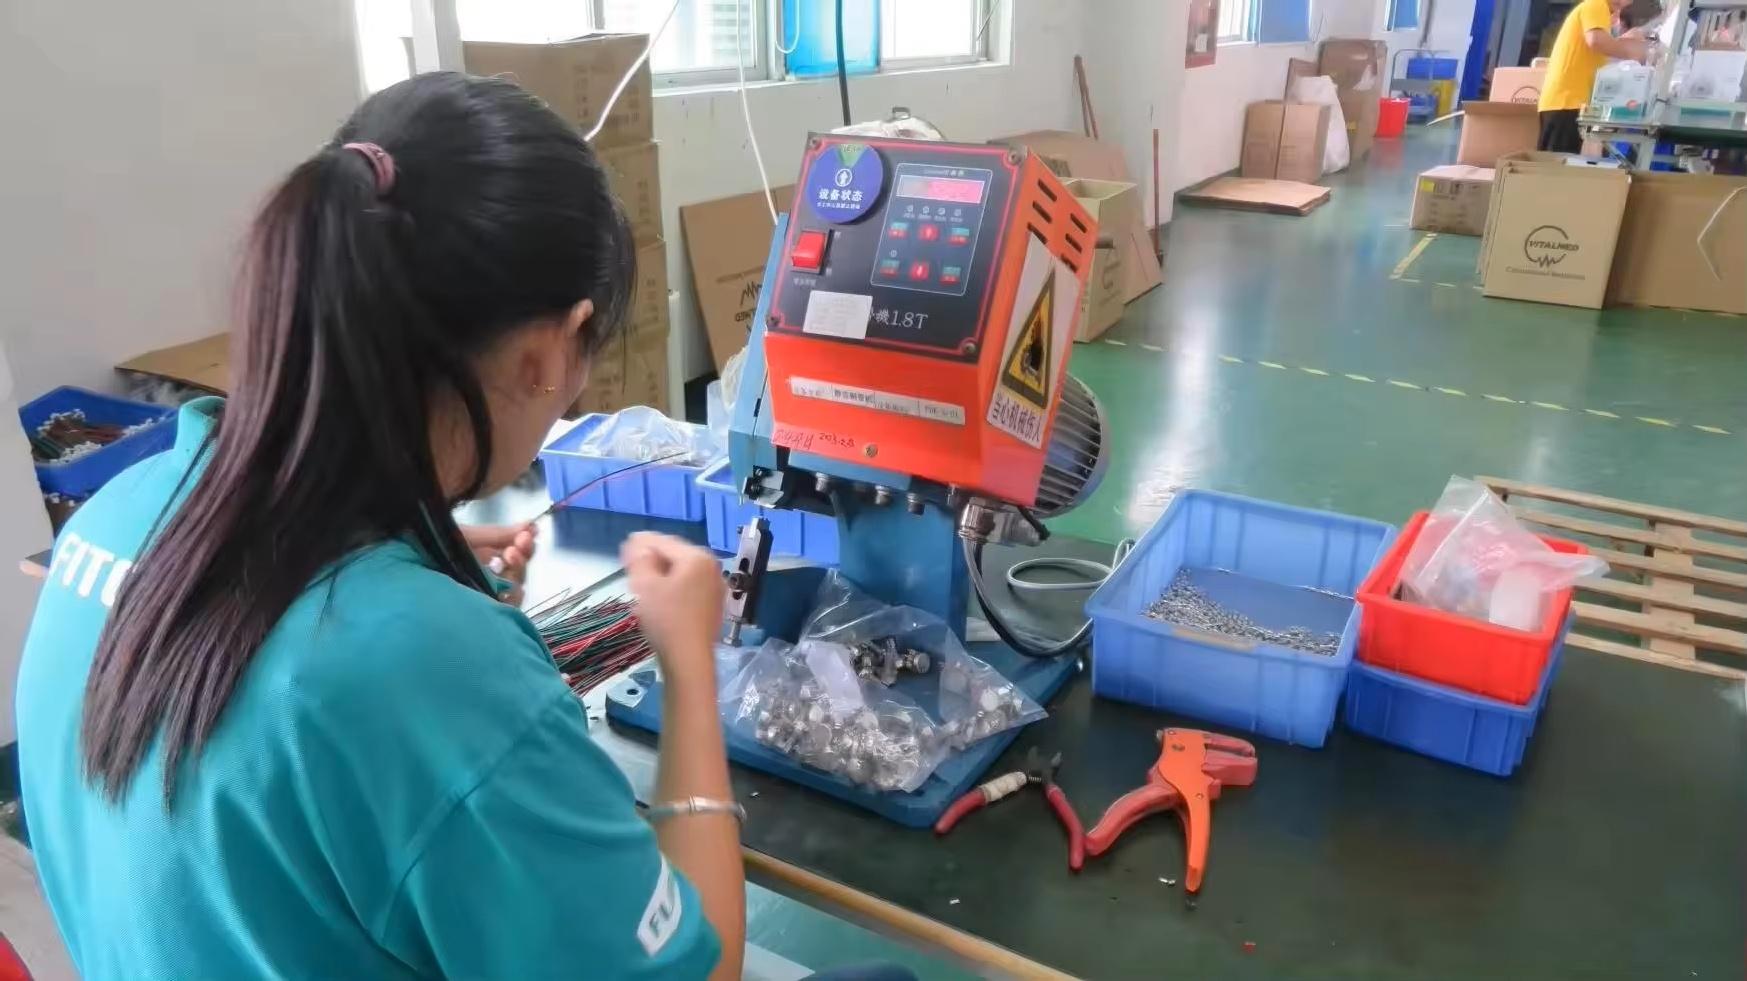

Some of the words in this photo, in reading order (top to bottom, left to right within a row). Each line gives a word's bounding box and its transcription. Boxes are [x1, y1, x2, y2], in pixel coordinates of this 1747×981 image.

[818, 188, 864, 202] 设备状态
[1528, 240, 1580, 252] VITALMED
[992, 391, 1042, 442] 当心机械伤人
